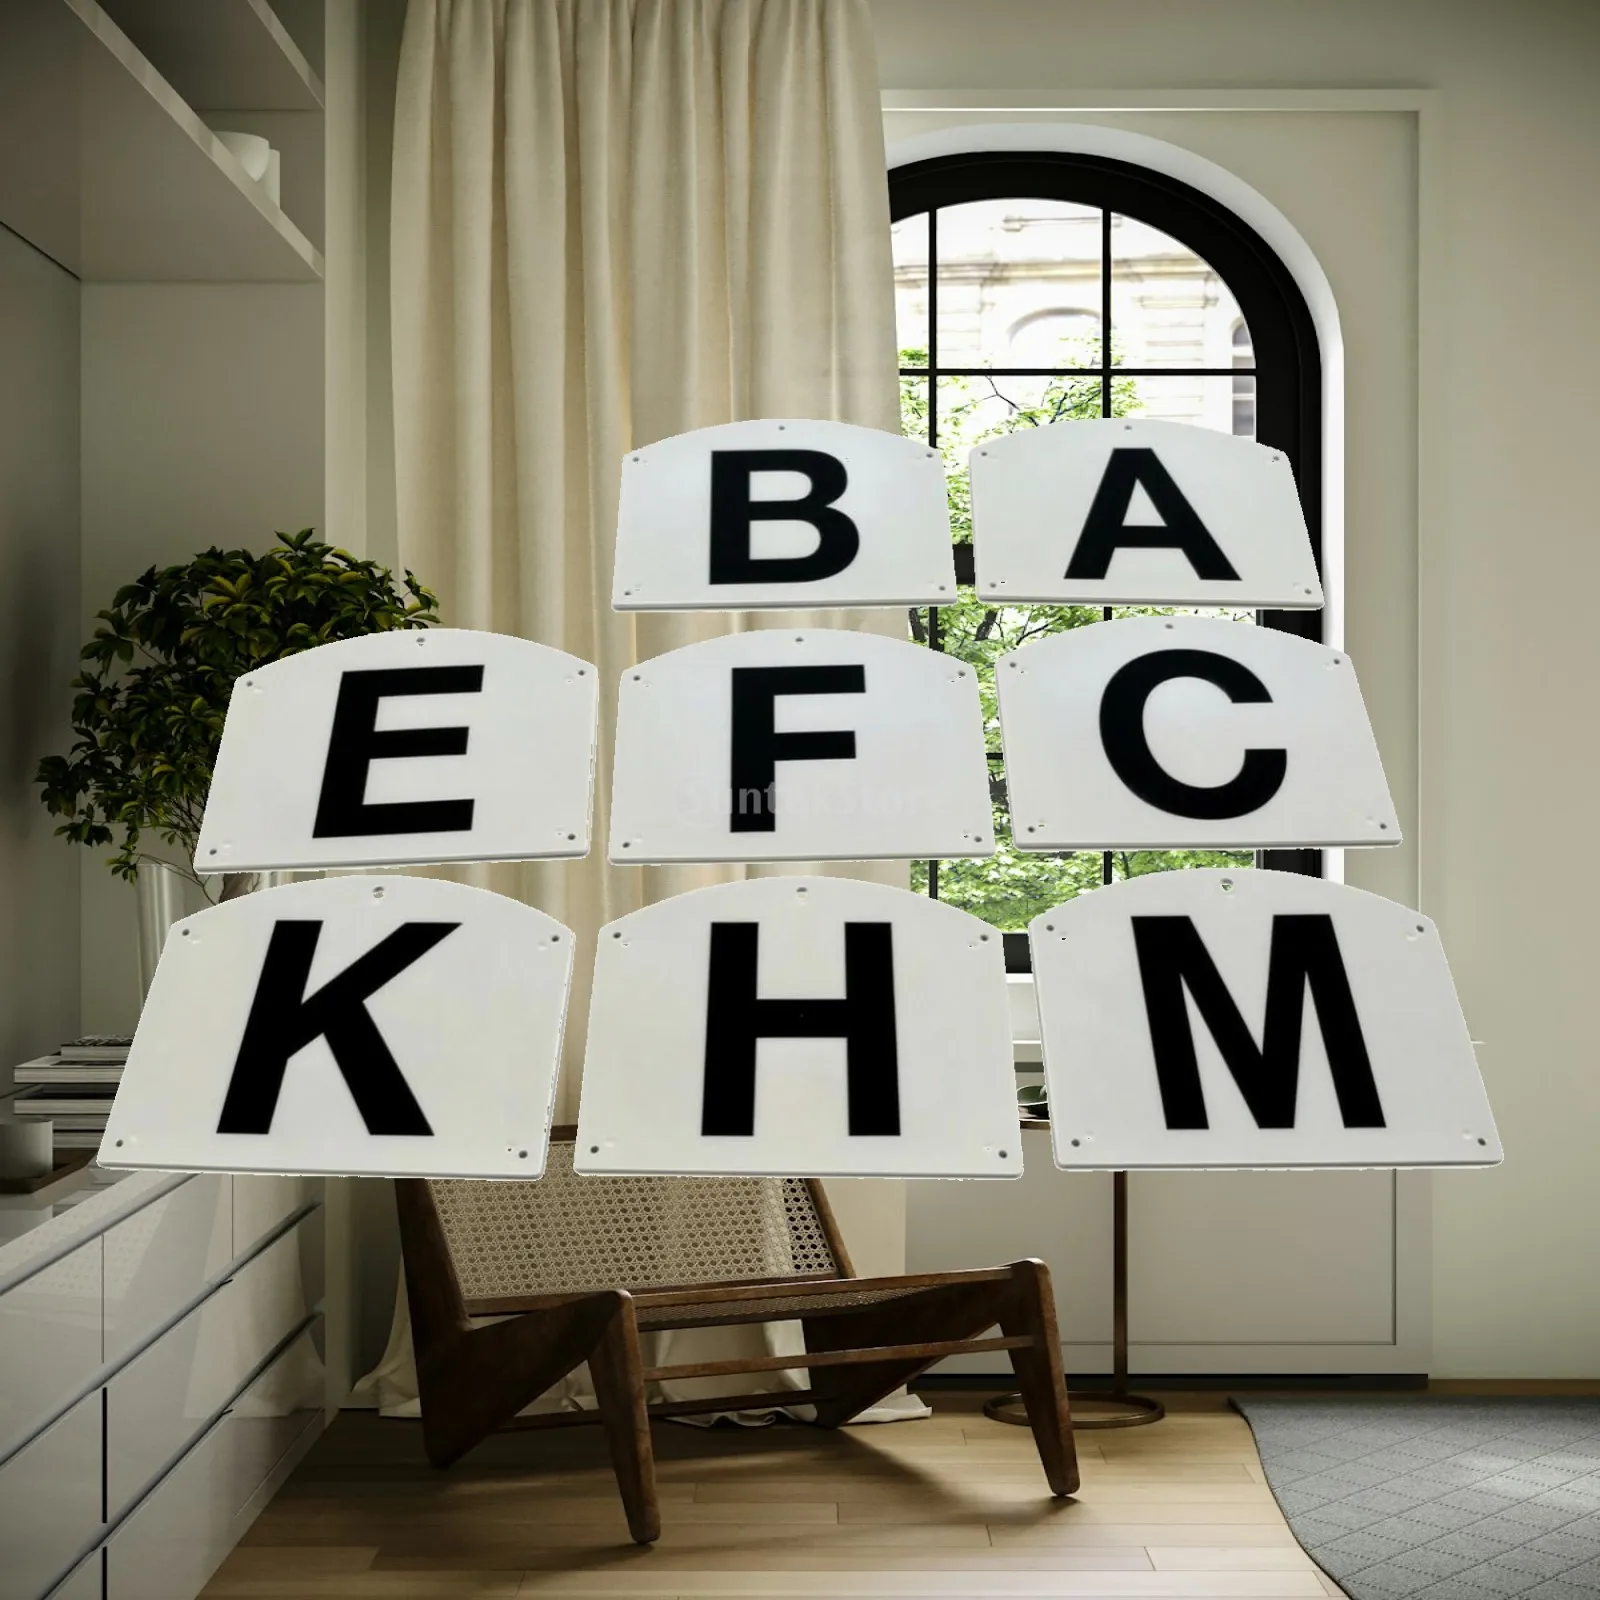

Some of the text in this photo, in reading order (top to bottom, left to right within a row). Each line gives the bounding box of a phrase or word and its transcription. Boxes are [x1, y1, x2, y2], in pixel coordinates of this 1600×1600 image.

[710, 449, 859, 585] B
[1064, 447, 1241, 580] A
[313, 664, 484, 838] E
[731, 664, 866, 833] F
[1099, 648, 1287, 820] C
[216, 919, 462, 1136] K
[701, 921, 901, 1137] H
[1130, 913, 1387, 1130] M
